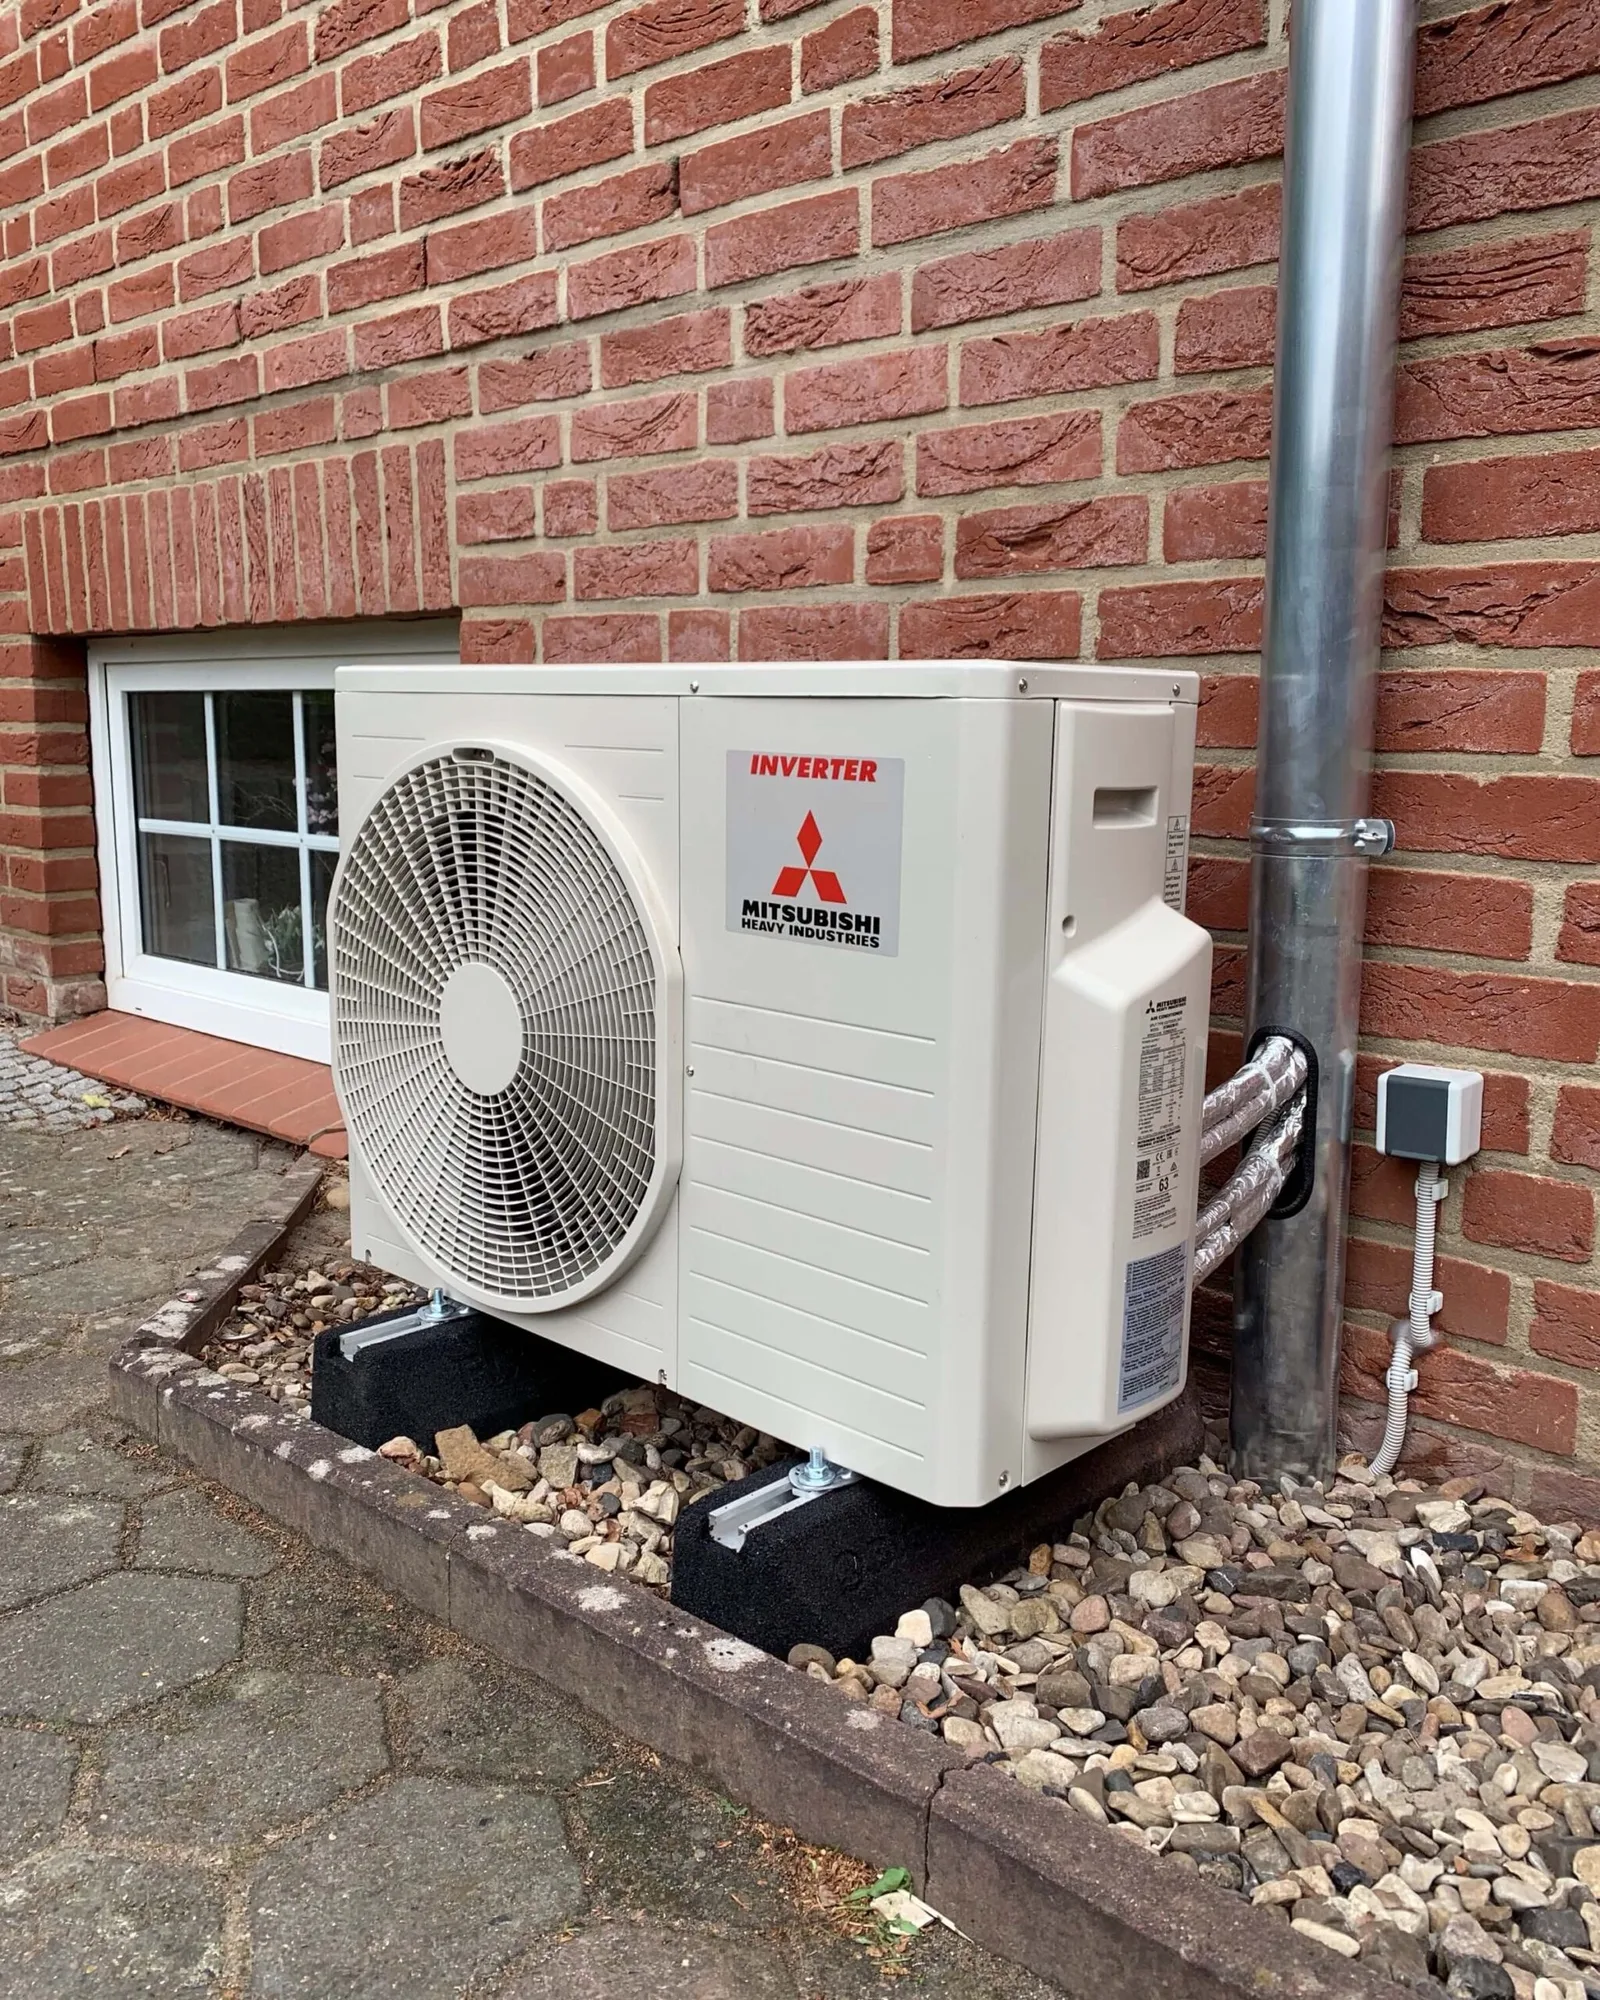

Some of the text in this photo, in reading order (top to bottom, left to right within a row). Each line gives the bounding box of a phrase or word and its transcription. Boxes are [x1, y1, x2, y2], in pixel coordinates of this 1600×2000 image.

[750, 754, 878, 783] INVERTER
[741, 898, 881, 935] MITSUBISHI
[741, 917, 880, 949] HEAVY INDUSTRIES
[1158, 1177, 1169, 1192] 63
